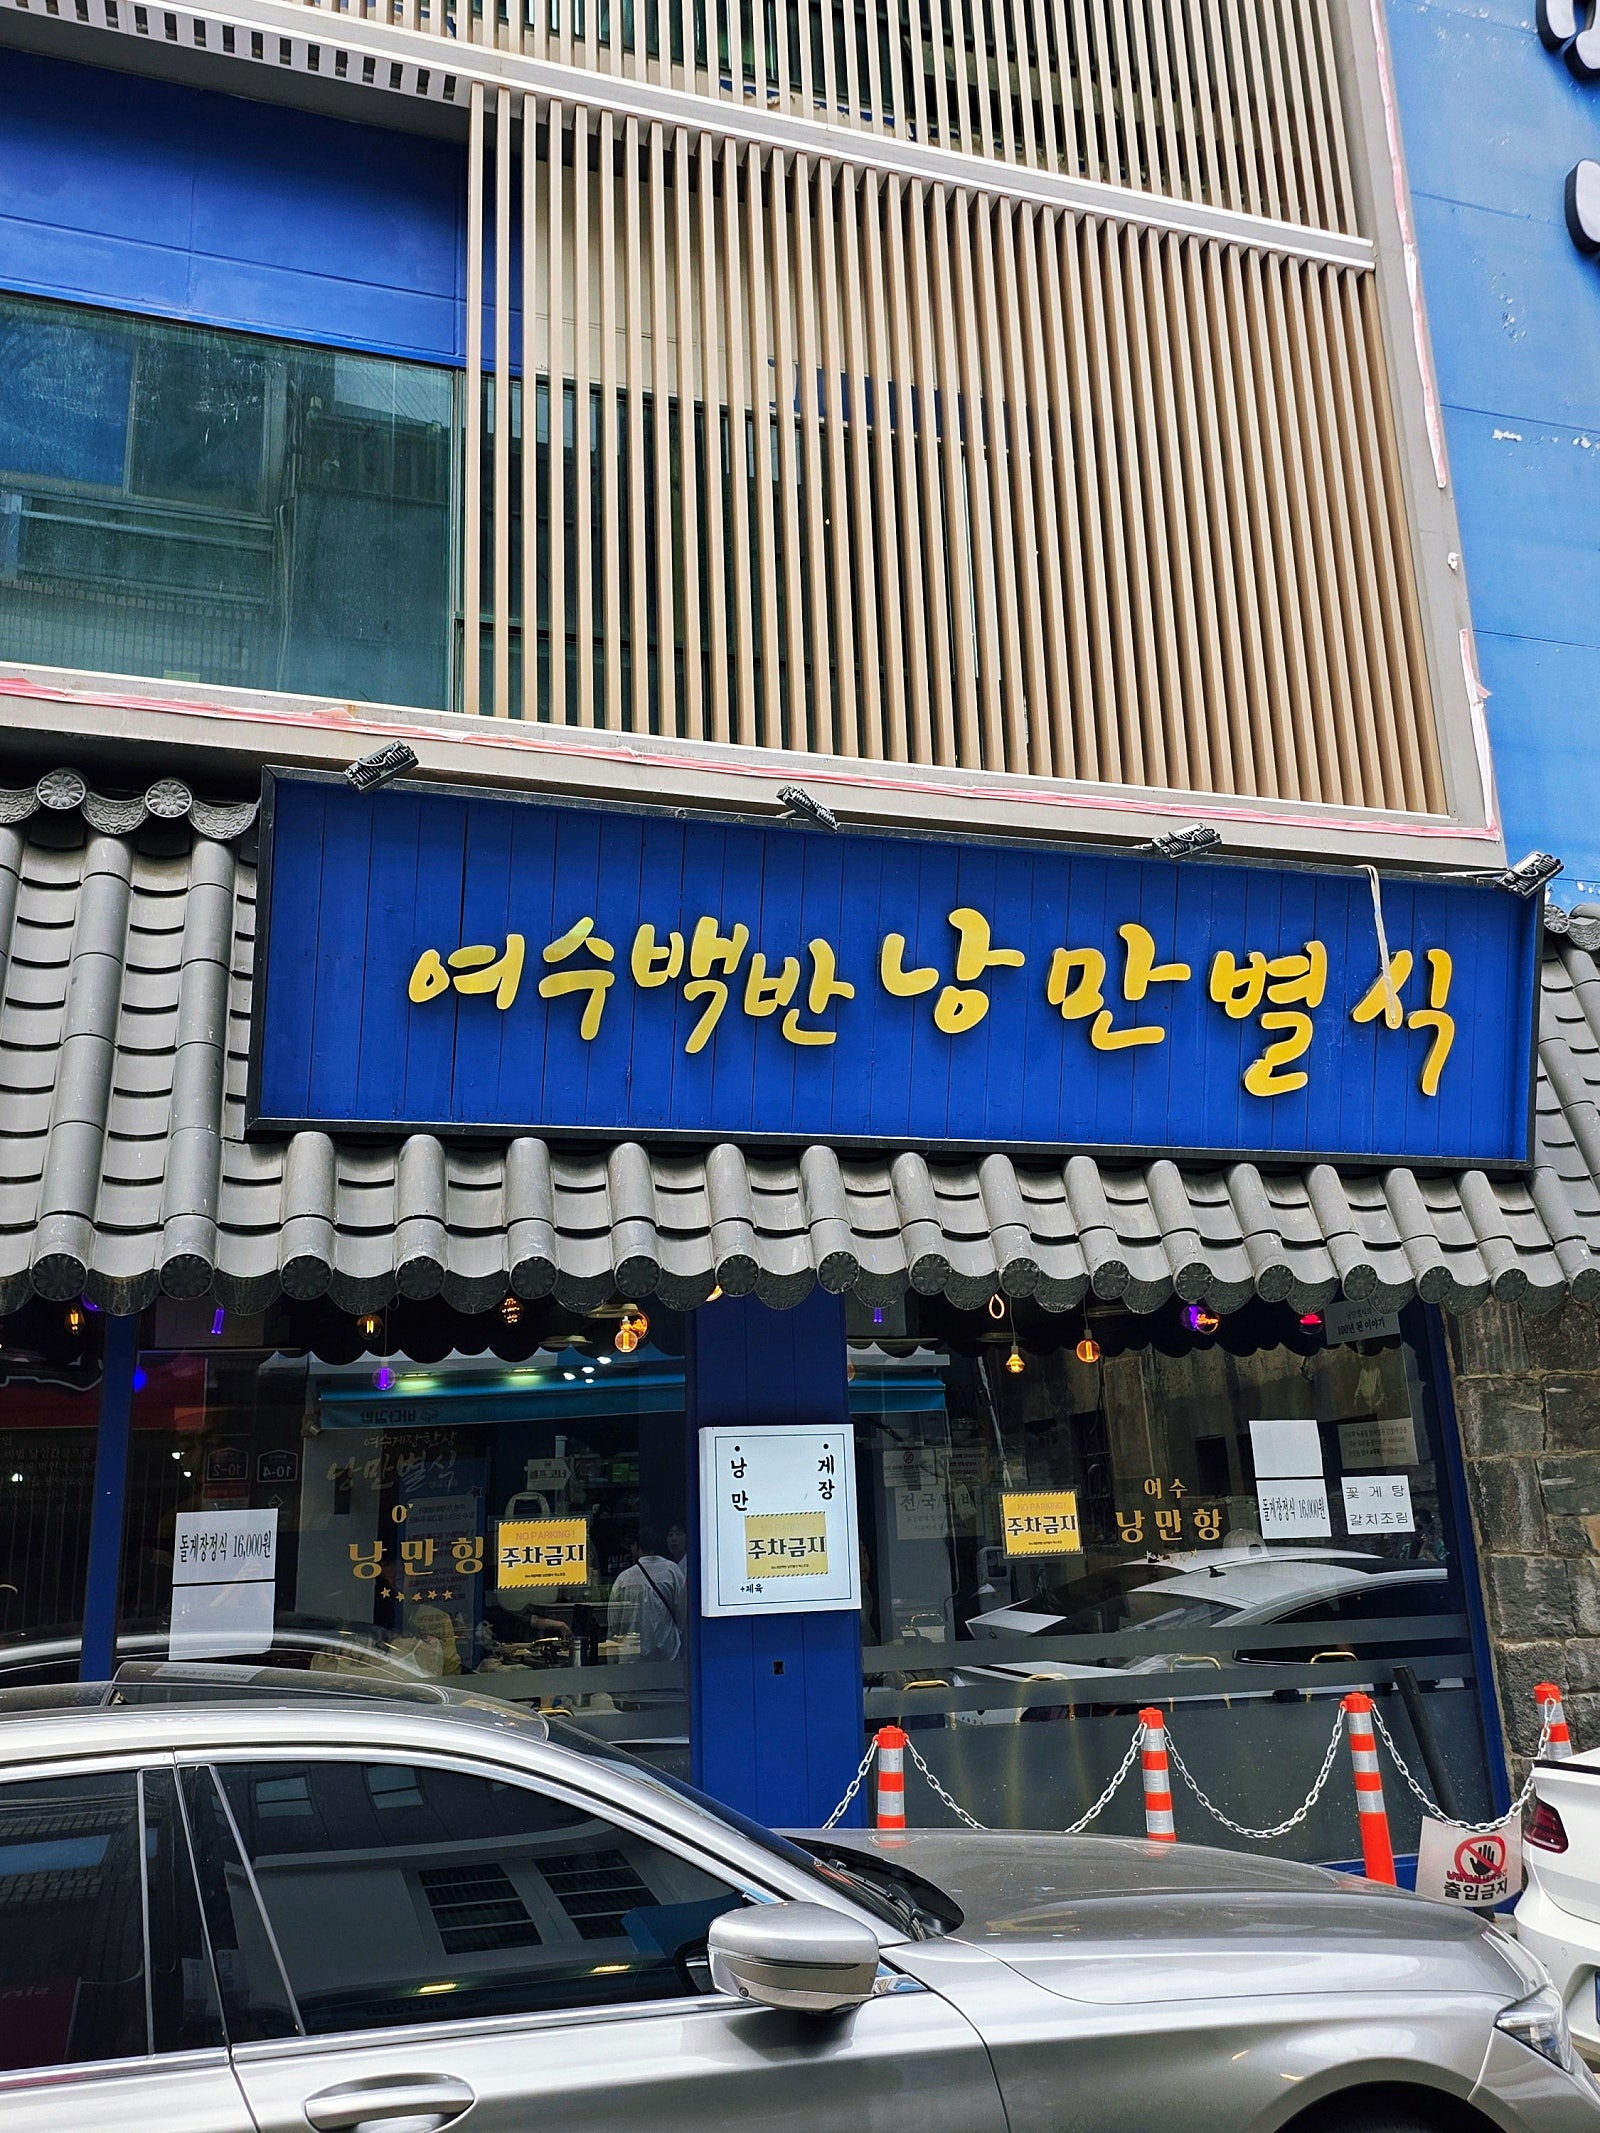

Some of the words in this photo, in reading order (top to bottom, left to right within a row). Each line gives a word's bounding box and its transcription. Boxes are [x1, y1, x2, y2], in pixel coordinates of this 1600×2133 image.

[408, 916, 856, 1055] 여수백반
[881, 907, 1456, 1097] 낭만별식
[1364, 1316, 1386, 1330] 이야기
[326, 1449, 457, 1494] 낭만별식
[817, 1454, 836, 1500] 게장
[1143, 1477, 1189, 1500] 여수
[1261, 1497, 1296, 1522] 돌게장정식
[1297, 1496, 1327, 1521] 16,000원
[1348, 1511, 1409, 1527] 갈치조림
[1007, 1515, 1077, 1536] 주차금지
[179, 1532, 228, 1563] 돌게장정식
[232, 1529, 272, 1560] 16,000원
[500, 1544, 585, 1568] 주차금지
[748, 1536, 826, 1560] 주차금지
[1442, 1877, 1508, 1901] 출입금지
